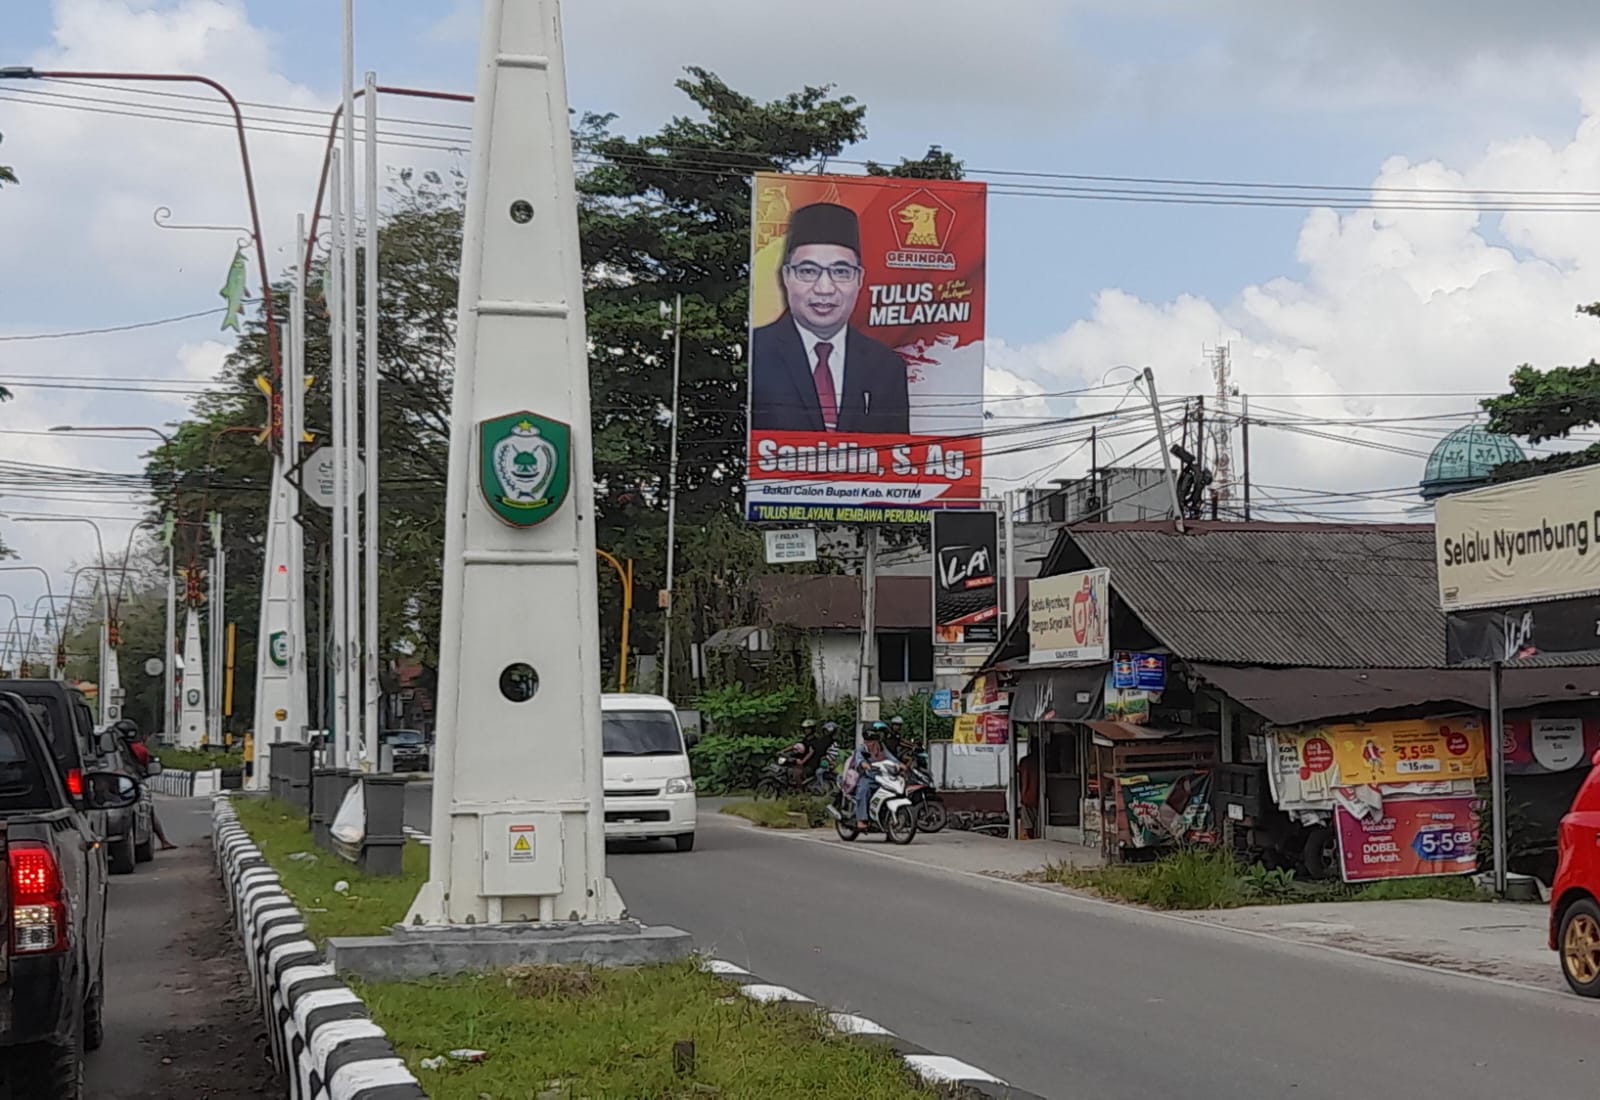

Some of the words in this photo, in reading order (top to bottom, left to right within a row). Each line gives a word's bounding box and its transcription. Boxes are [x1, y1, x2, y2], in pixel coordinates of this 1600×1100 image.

[887, 252, 954, 264] GERINDRA
[869, 283, 933, 304] TULUS
[868, 302, 970, 326] MELAYANI
[892, 444, 920, 476] S.
[924, 444, 972, 480] Ag.
[795, 486, 824, 497] Calon
[825, 486, 860, 499] Bupati
[861, 487, 884, 498] Kab.
[886, 488, 922, 499] KOTIM
[836, 508, 883, 523] MEMBAWA
[1444, 530, 1490, 566] Selalu
[1494, 517, 1589, 566] Nyambung
